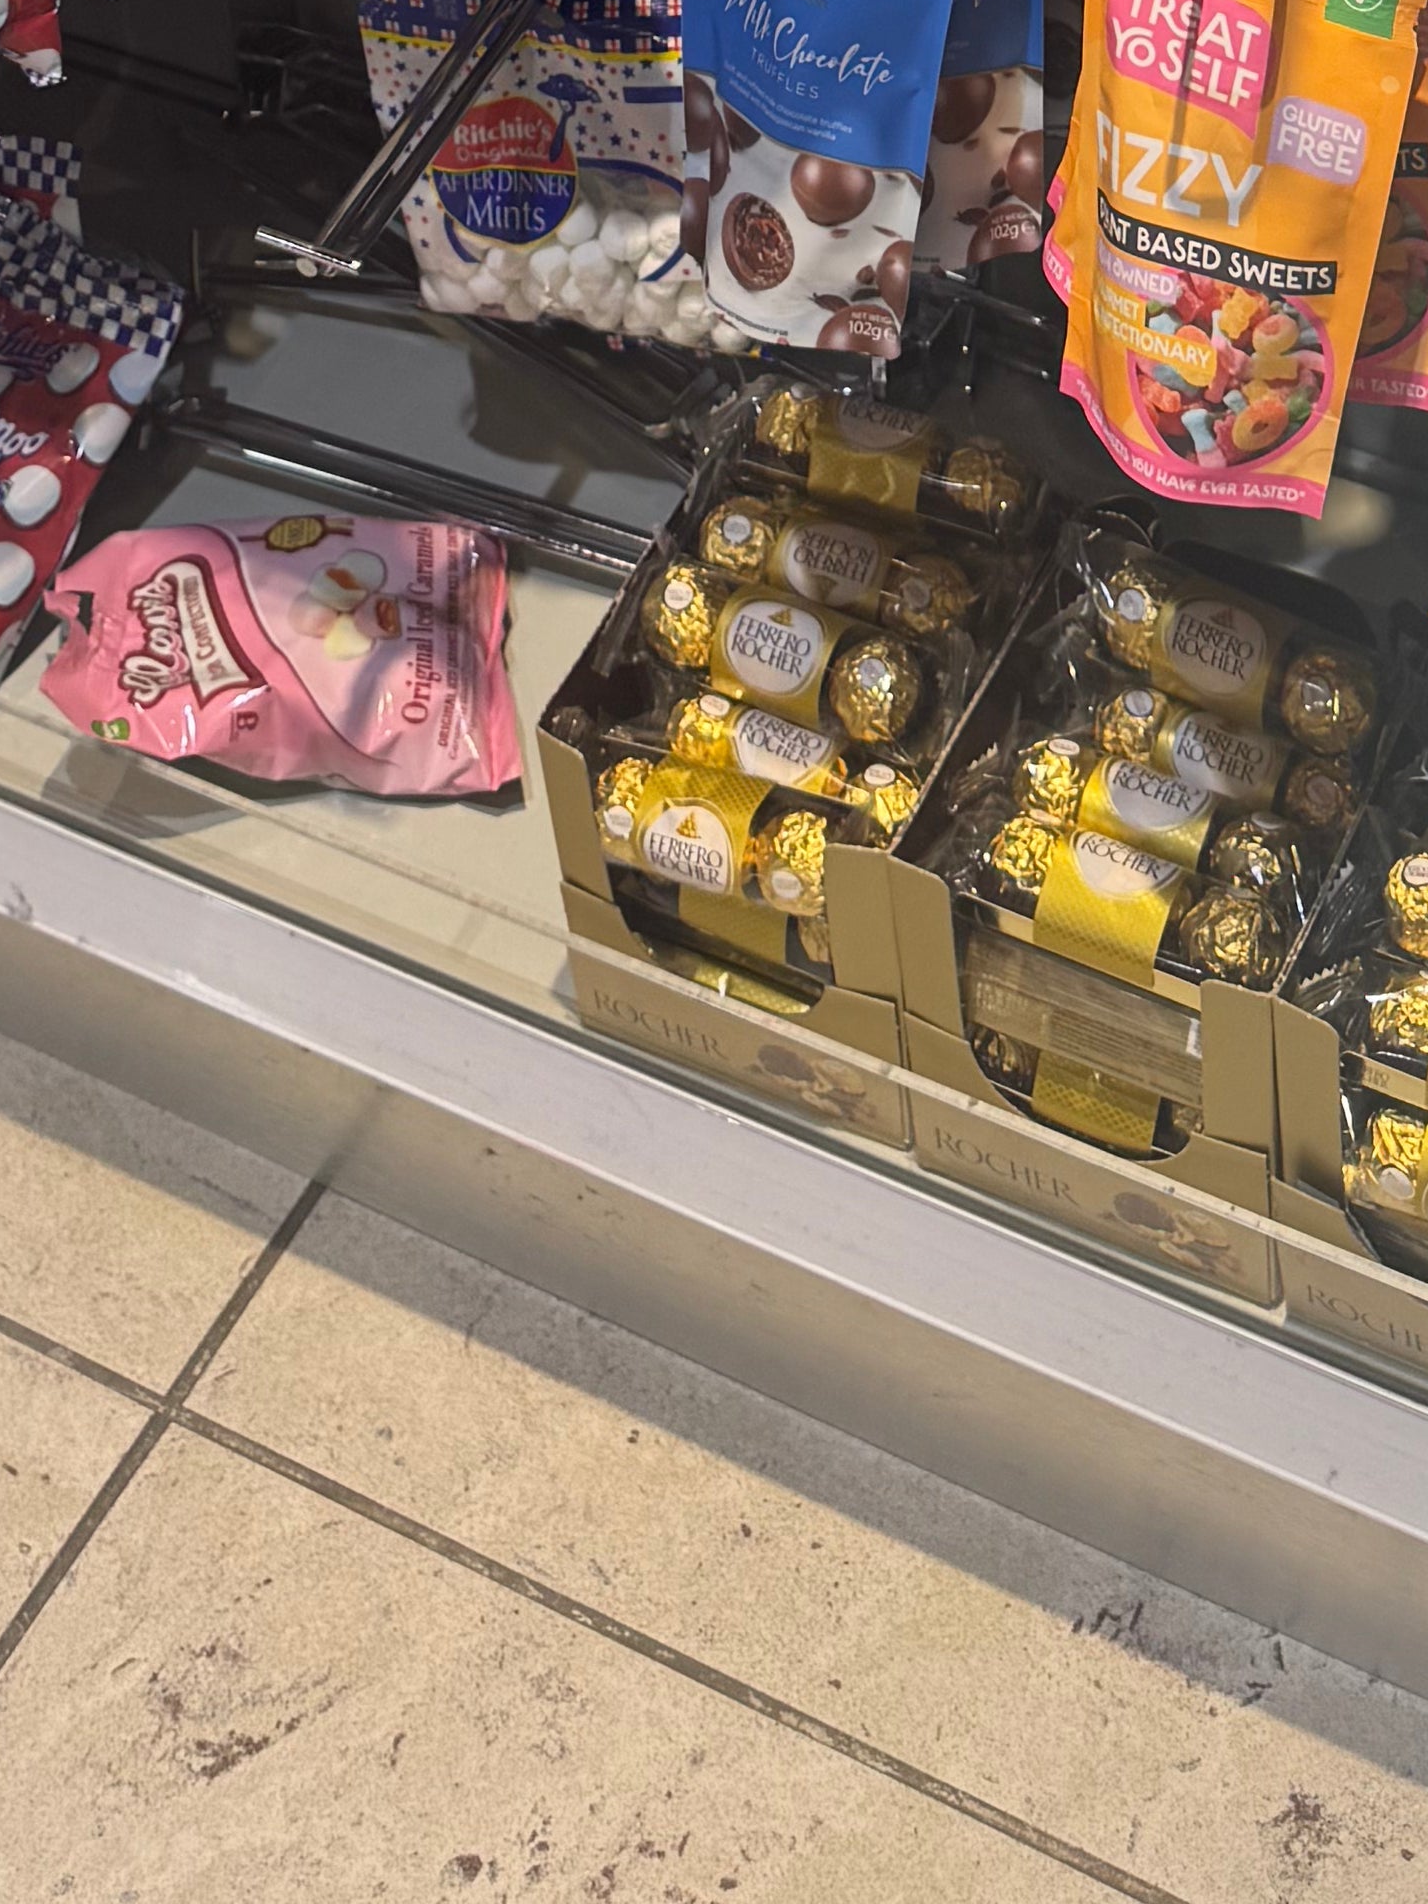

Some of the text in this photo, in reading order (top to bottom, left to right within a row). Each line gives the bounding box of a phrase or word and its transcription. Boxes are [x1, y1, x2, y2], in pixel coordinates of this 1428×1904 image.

[452, 118, 553, 146] Ritchie's
[455, 140, 550, 165] Original
[1096, 108, 1264, 226] FIZZY
[439, 171, 569, 197] AFTER DINNER
[466, 195, 545, 232] Mints
[737, 615, 812, 660] FERRERO
[732, 637, 803, 676] ROCHER
